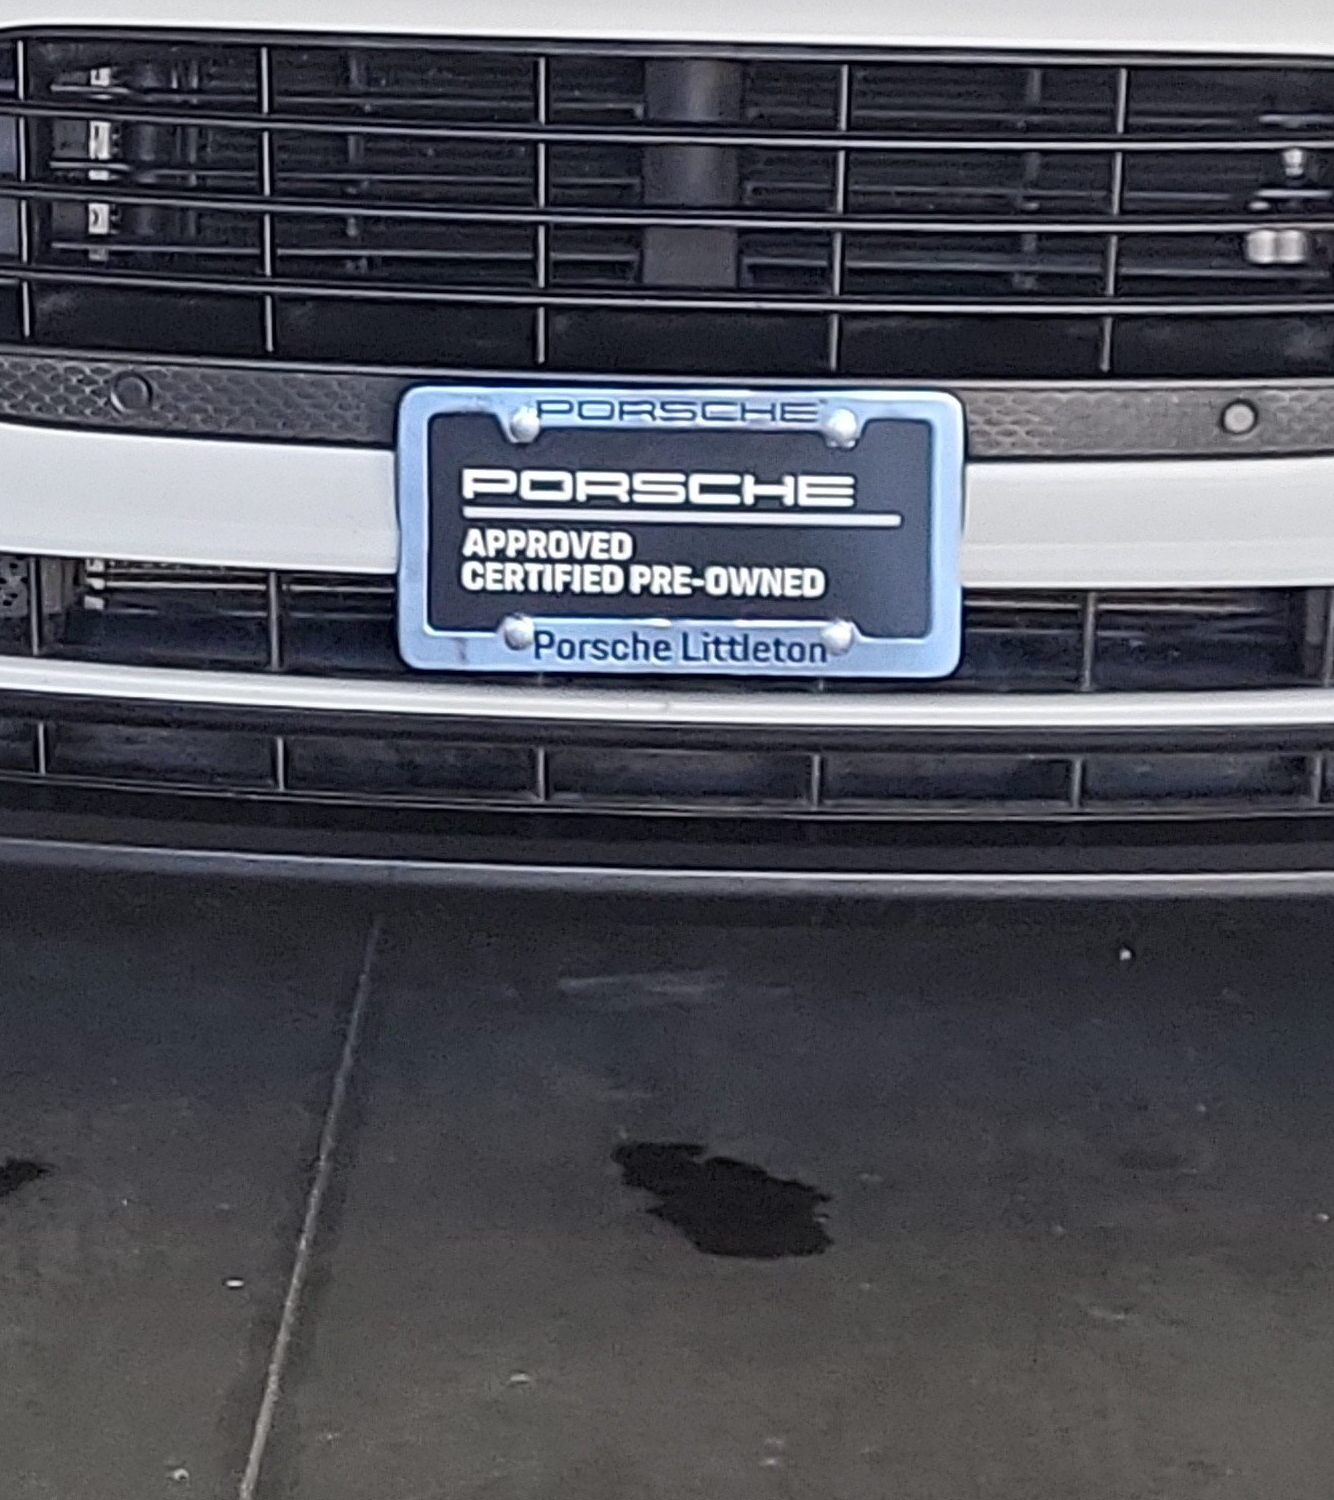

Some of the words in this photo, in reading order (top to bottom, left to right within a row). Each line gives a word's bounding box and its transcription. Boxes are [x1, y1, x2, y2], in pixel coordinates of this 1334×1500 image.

[535, 399, 817, 423] PORSCHE
[462, 468, 856, 508] PORSCHE
[462, 528, 634, 562] APPROVED
[461, 561, 625, 595] CERTIFIED
[628, 565, 827, 599] PRE-OWNED
[534, 630, 672, 662] Porsche
[681, 631, 828, 664] Littleton
